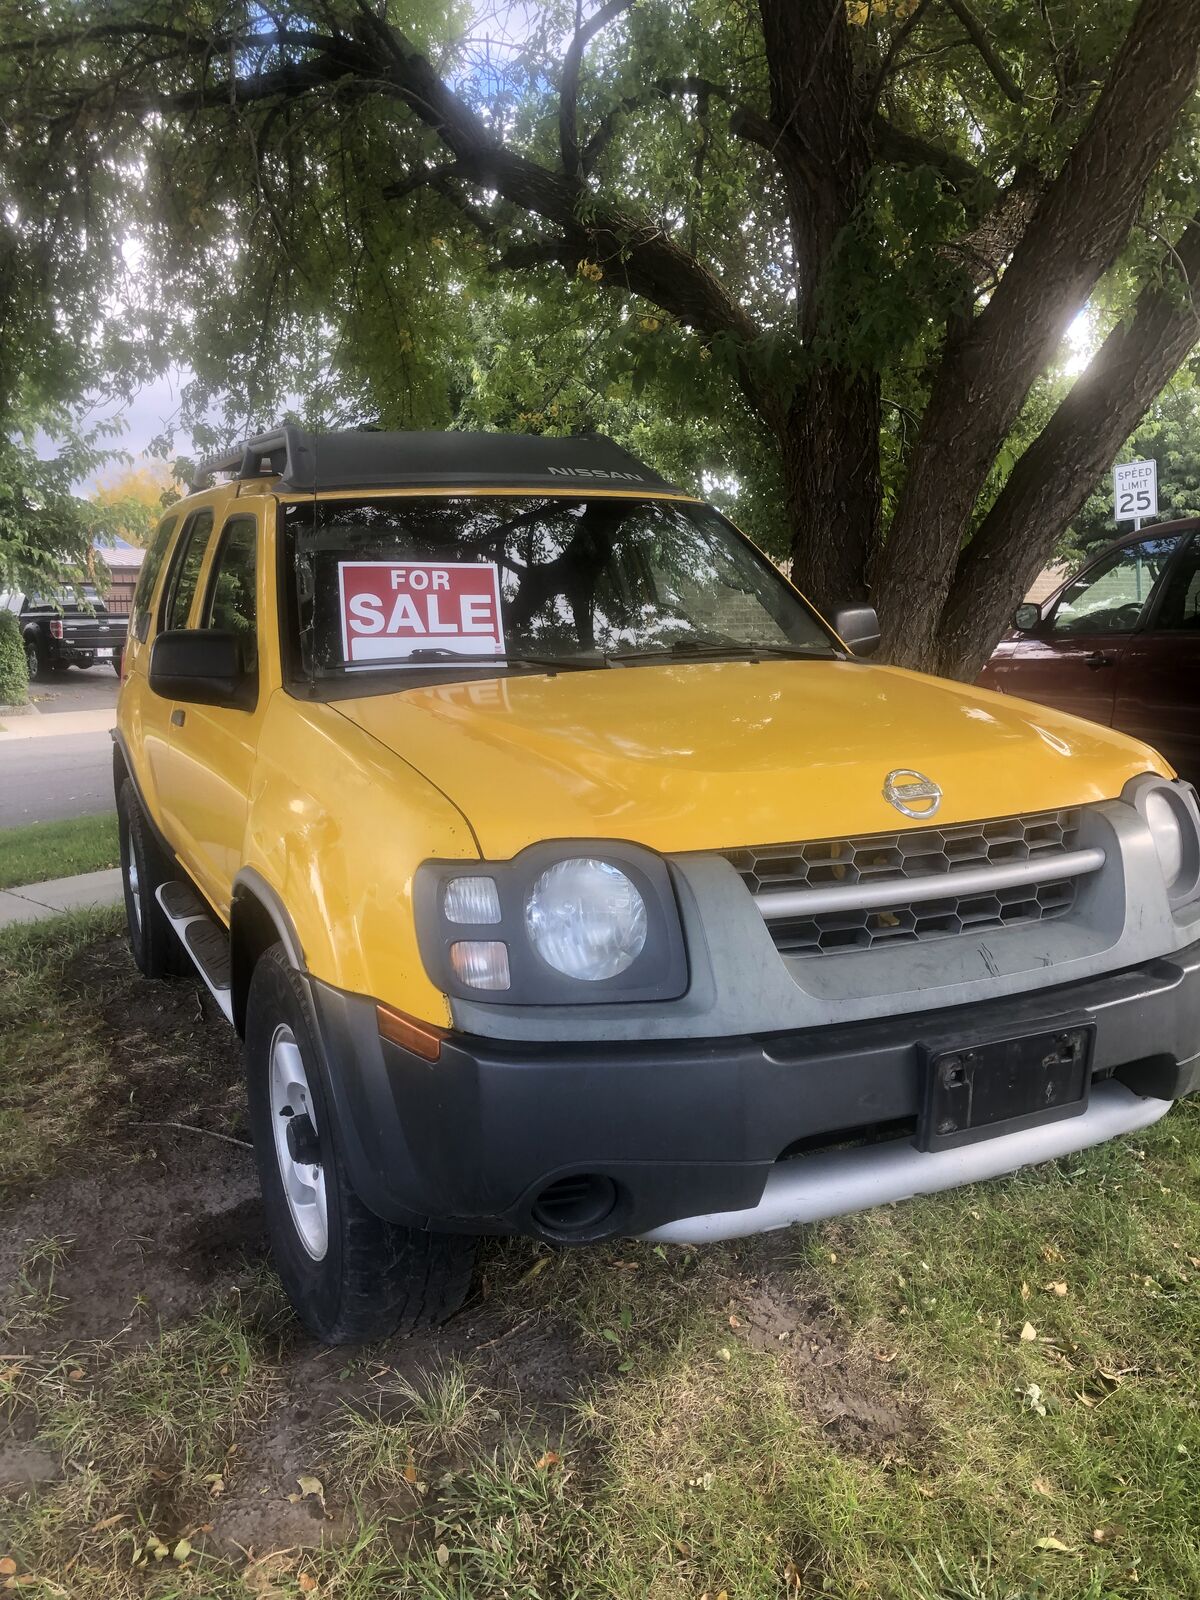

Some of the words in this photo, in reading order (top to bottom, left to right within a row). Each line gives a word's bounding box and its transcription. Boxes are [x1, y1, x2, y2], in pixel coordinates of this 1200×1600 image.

[547, 466, 644, 482] NISSAN
[1118, 467, 1152, 481] SPEED
[1121, 479, 1148, 492] LIMIT
[1120, 490, 1152, 514] 25
[390, 569, 450, 590] FOR
[349, 593, 495, 635] SALE
